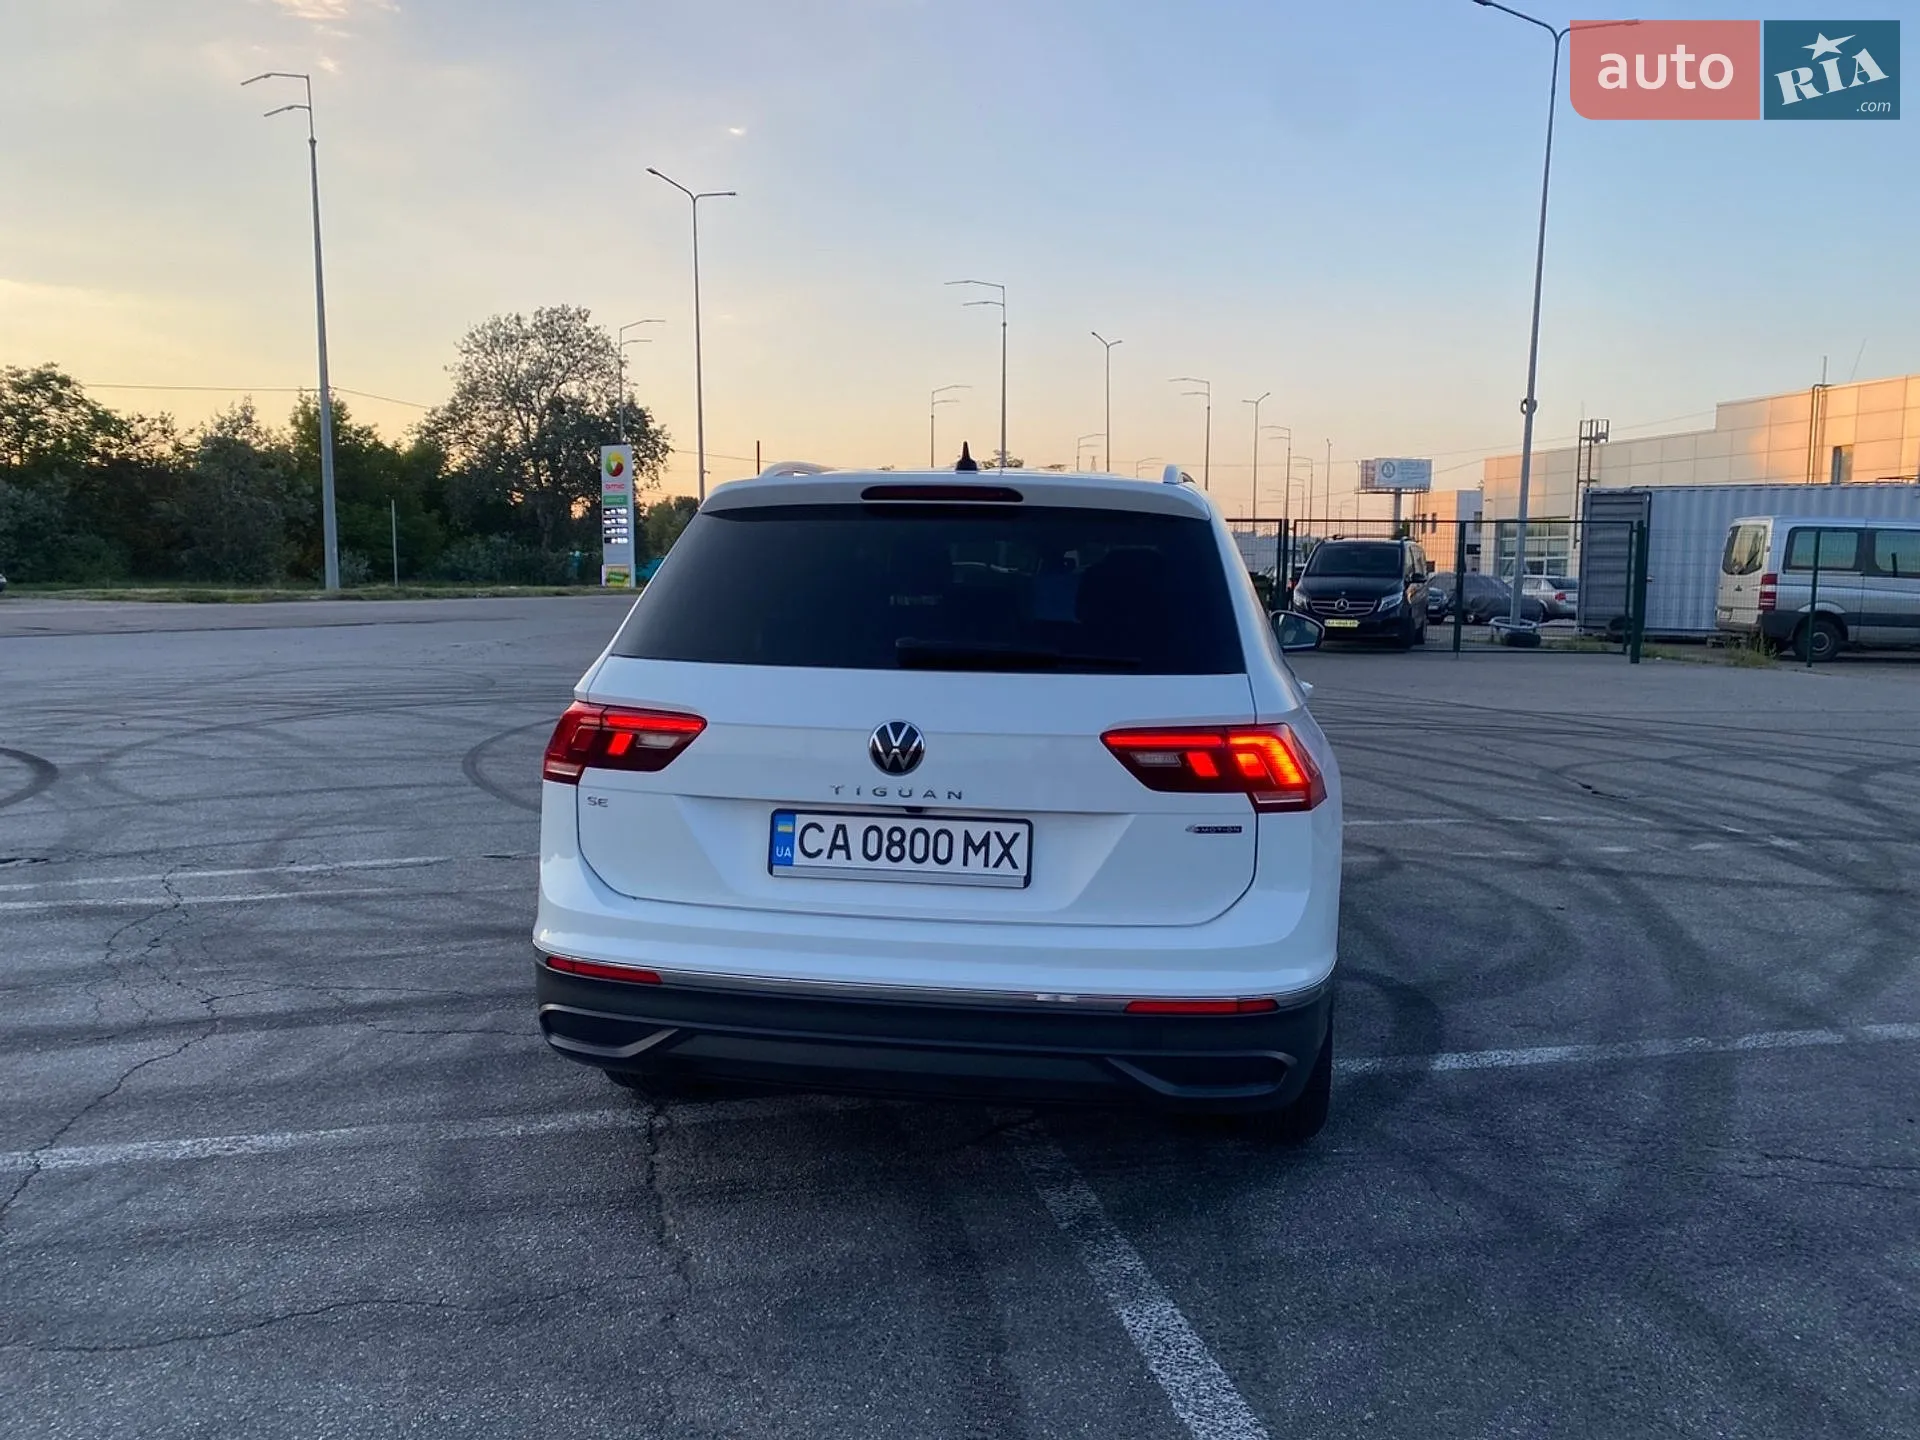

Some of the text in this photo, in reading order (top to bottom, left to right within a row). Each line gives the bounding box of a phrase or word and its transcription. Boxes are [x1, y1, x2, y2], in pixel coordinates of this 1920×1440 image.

[830, 784, 963, 800] TIGUAN
[587, 796, 609, 808] SE
[775, 846, 792, 858] UA
[799, 822, 1020, 870] CA 0800 MX
